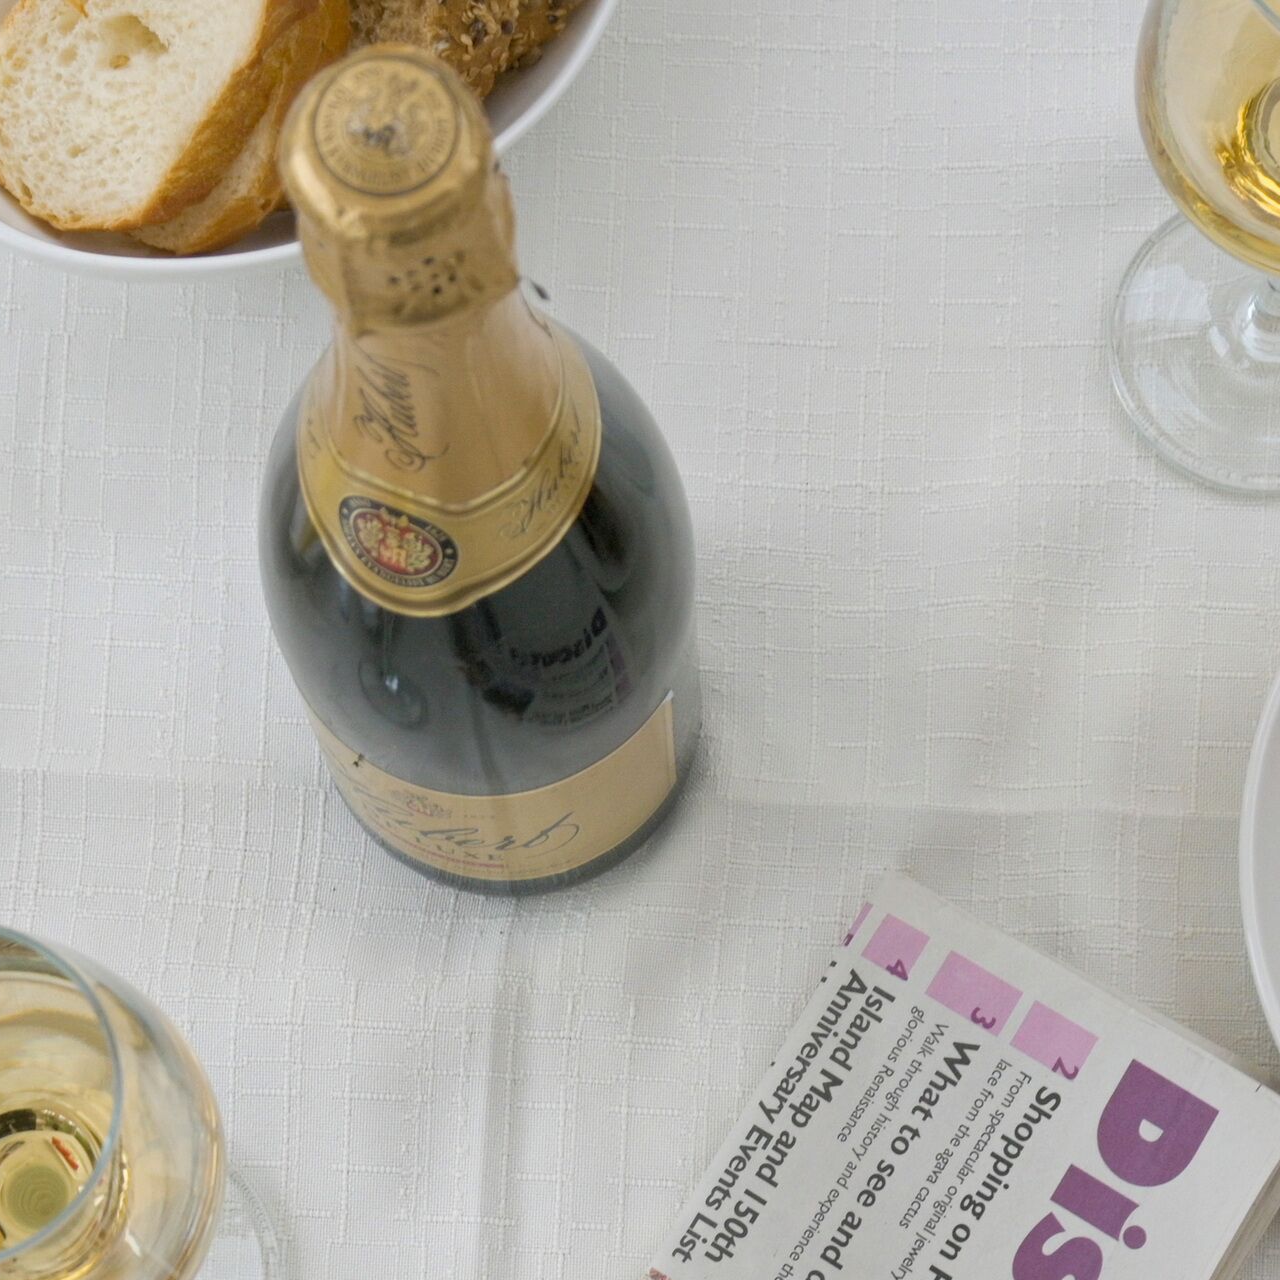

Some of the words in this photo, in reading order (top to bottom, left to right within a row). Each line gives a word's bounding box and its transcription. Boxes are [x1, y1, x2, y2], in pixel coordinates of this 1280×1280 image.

[885, 958, 909, 981] 4
[828, 985, 896, 1072] Island
[887, 1005, 925, 1063] glorious
[916, 1023, 950, 1059] Walk
[970, 1006, 997, 1030] 3
[758, 968, 868, 1125] Anniversary
[986, 1058, 1013, 1087] lace
[1051, 1056, 1080, 1081] 2
[788, 1068, 844, 1128] Map
[836, 1064, 895, 1143] Renaissance
[883, 1058, 923, 1112] through
[911, 1041, 981, 1122] What
[965, 1087, 995, 1122] from
[1000, 1070, 1033, 1109] From
[754, 1130, 797, 1188] and
[851, 1112, 892, 1162] history
[890, 1124, 921, 1156] to
[949, 1123, 970, 1148] the
[956, 1109, 1005, 1185] spectacular
[959, 1086, 1062, 1221] Shopping
[705, 1124, 774, 1211] Events
[836, 1160, 858, 1190] and
[856, 1159, 895, 1208] see
[925, 1148, 954, 1185] agava
[704, 1188, 768, 1263] 150th
[789, 1188, 840, 1262] experience
[898, 1186, 930, 1230] cactus
[923, 1185, 958, 1237] original
[671, 1212, 719, 1264] List
[819, 1211, 863, 1271] and
[939, 1223, 971, 1261] on
